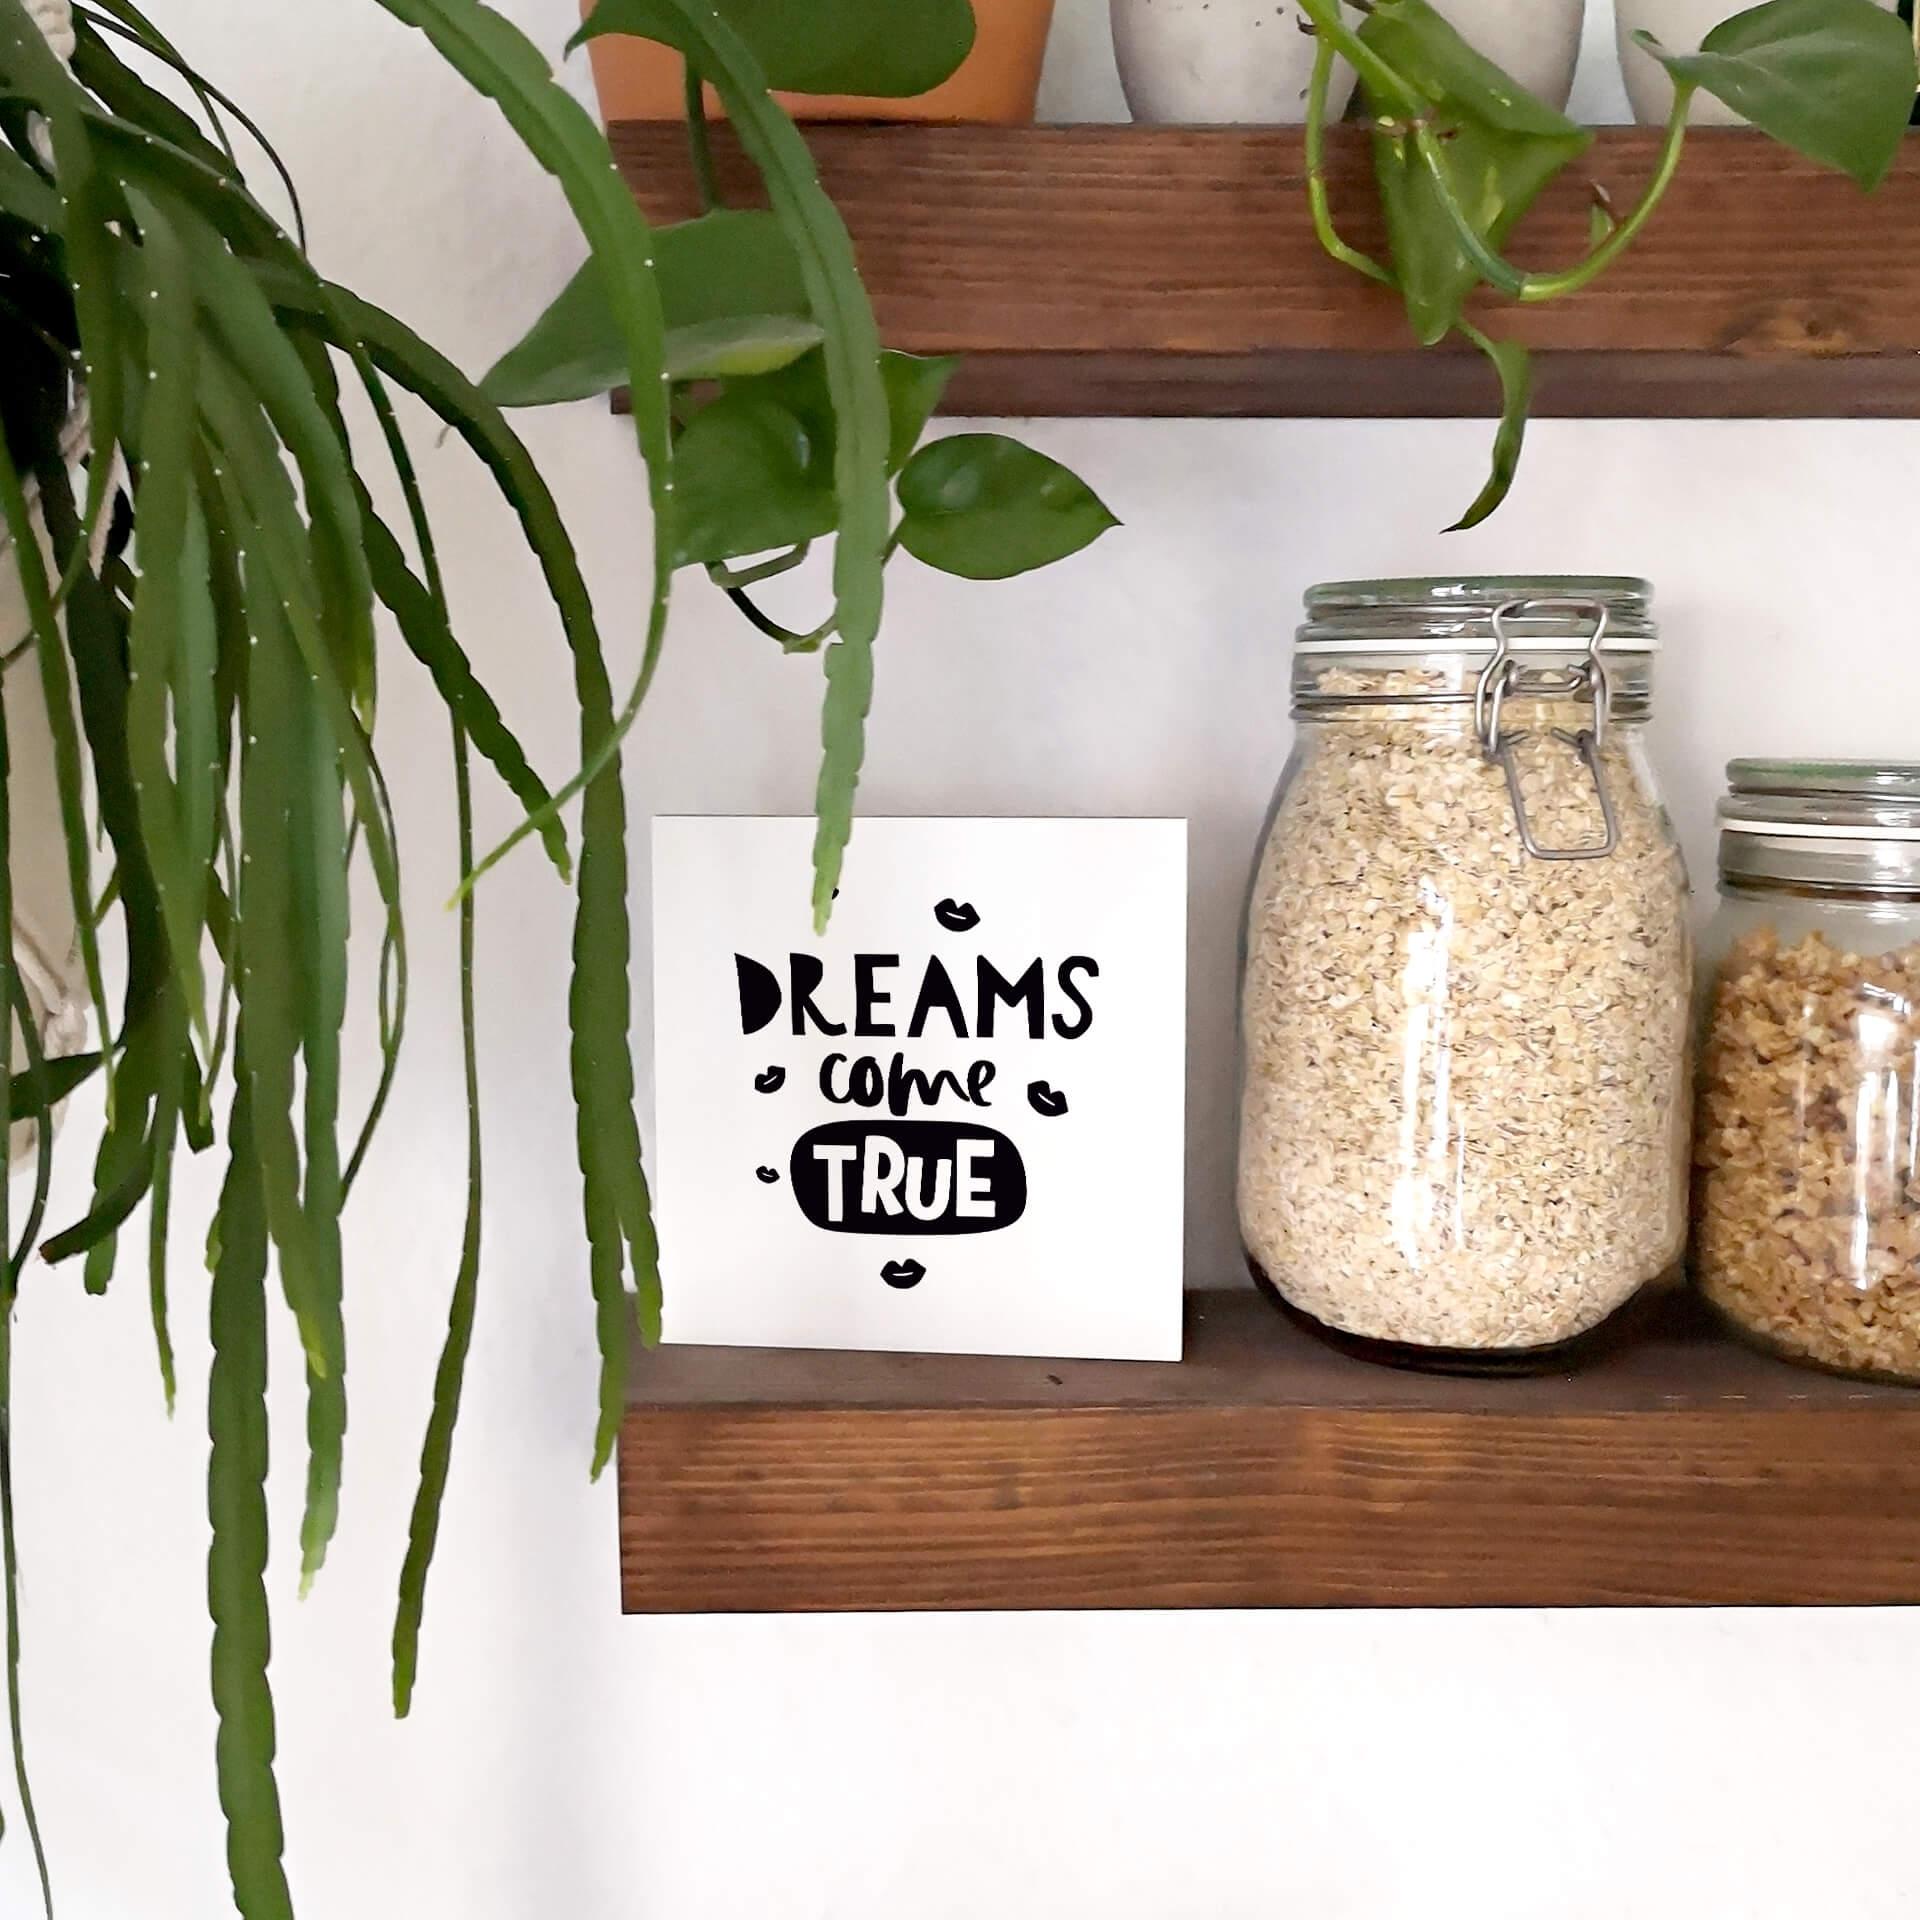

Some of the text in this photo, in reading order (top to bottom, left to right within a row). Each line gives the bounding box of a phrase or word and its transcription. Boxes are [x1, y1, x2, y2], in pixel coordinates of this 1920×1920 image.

[735, 953, 1099, 1039] DREAMS
[820, 1052, 996, 1116] come
[813, 1135, 996, 1222] TRUE
